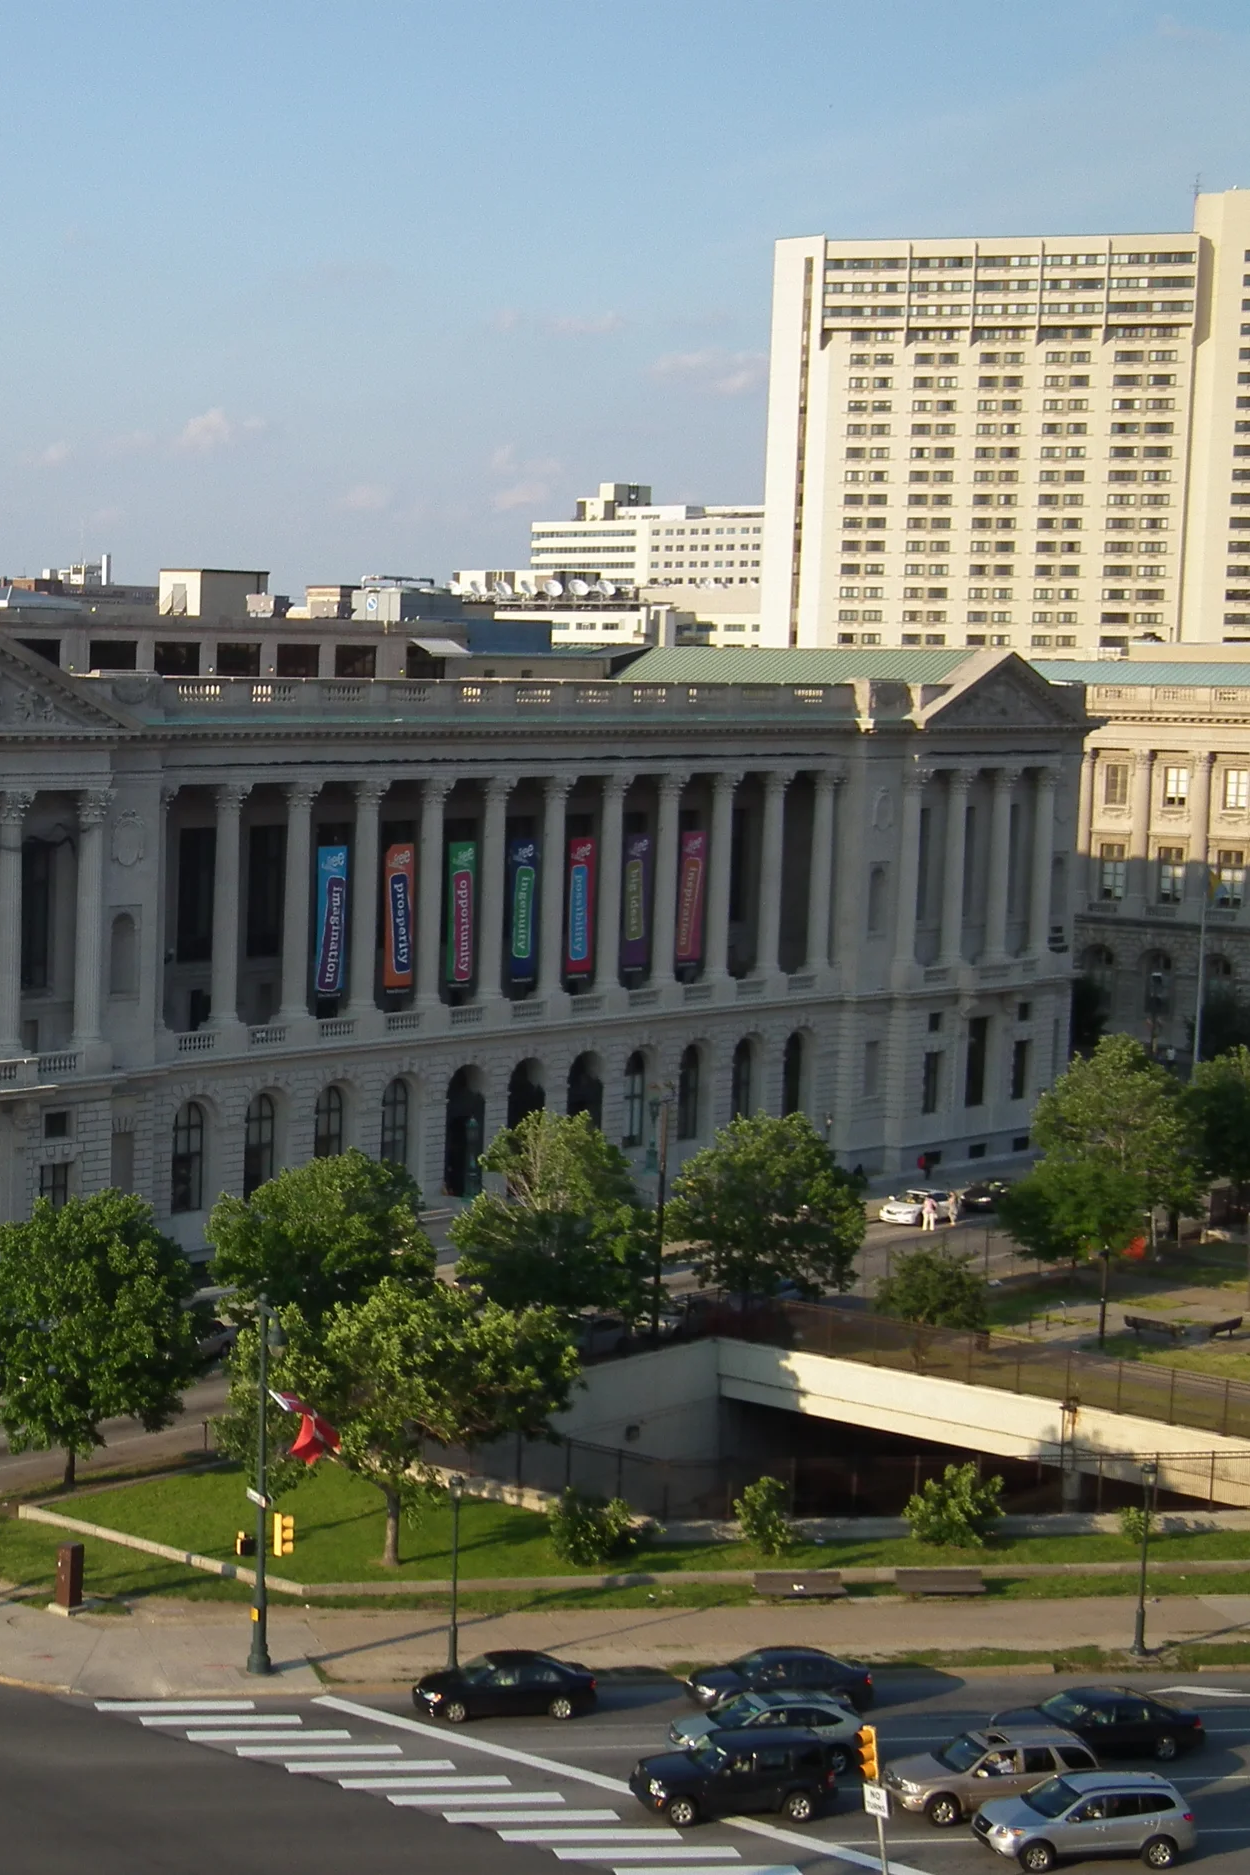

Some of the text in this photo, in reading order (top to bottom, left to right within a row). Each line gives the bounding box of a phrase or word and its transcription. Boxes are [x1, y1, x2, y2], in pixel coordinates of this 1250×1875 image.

[325, 886, 342, 983] imagination
[394, 882, 408, 965] prosperity
[457, 880, 471, 972] opportunity
[518, 876, 531, 949] ingenuity
[573, 874, 584, 952] possibility
[629, 869, 639, 932] big ideas
[680, 866, 698, 946] inspiration
[866, 1801, 885, 1812] TURNS
[870, 1791, 881, 1800] NO
